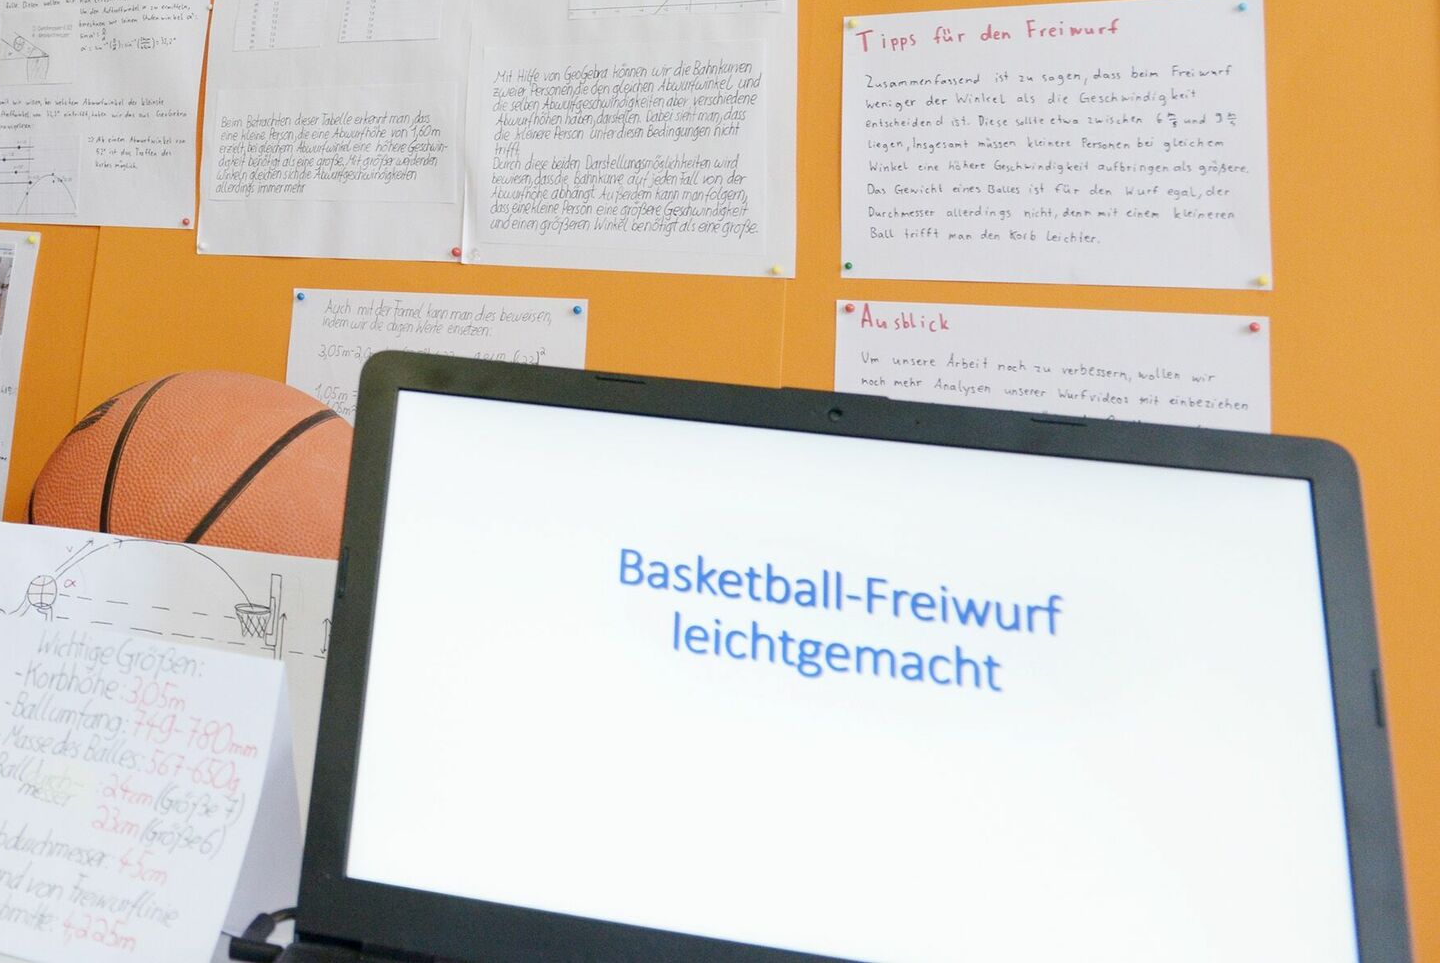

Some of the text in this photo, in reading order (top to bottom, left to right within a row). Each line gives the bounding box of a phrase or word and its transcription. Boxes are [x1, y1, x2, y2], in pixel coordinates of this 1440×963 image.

[856, 18, 1120, 53] Tipps für den Freiwurf
[613, 63, 647, 78] können
[673, 60, 691, 76] die
[865, 64, 1232, 89] Zusammenfassend ist zu sagen, dass beim Freiwurf
[861, 303, 950, 332] Ausblick
[861, 351, 1216, 383] Um unsere Arbeit noch zu verbessern, wollen wir
[861, 377, 1249, 411] noch mehr Analysen unserer Wurfvideos mit einbeziehen
[619, 548, 1063, 636] Basketball-Freiwurf
[37, 630, 116, 666] Wichtige
[673, 611, 1002, 691] leichtgemacht
